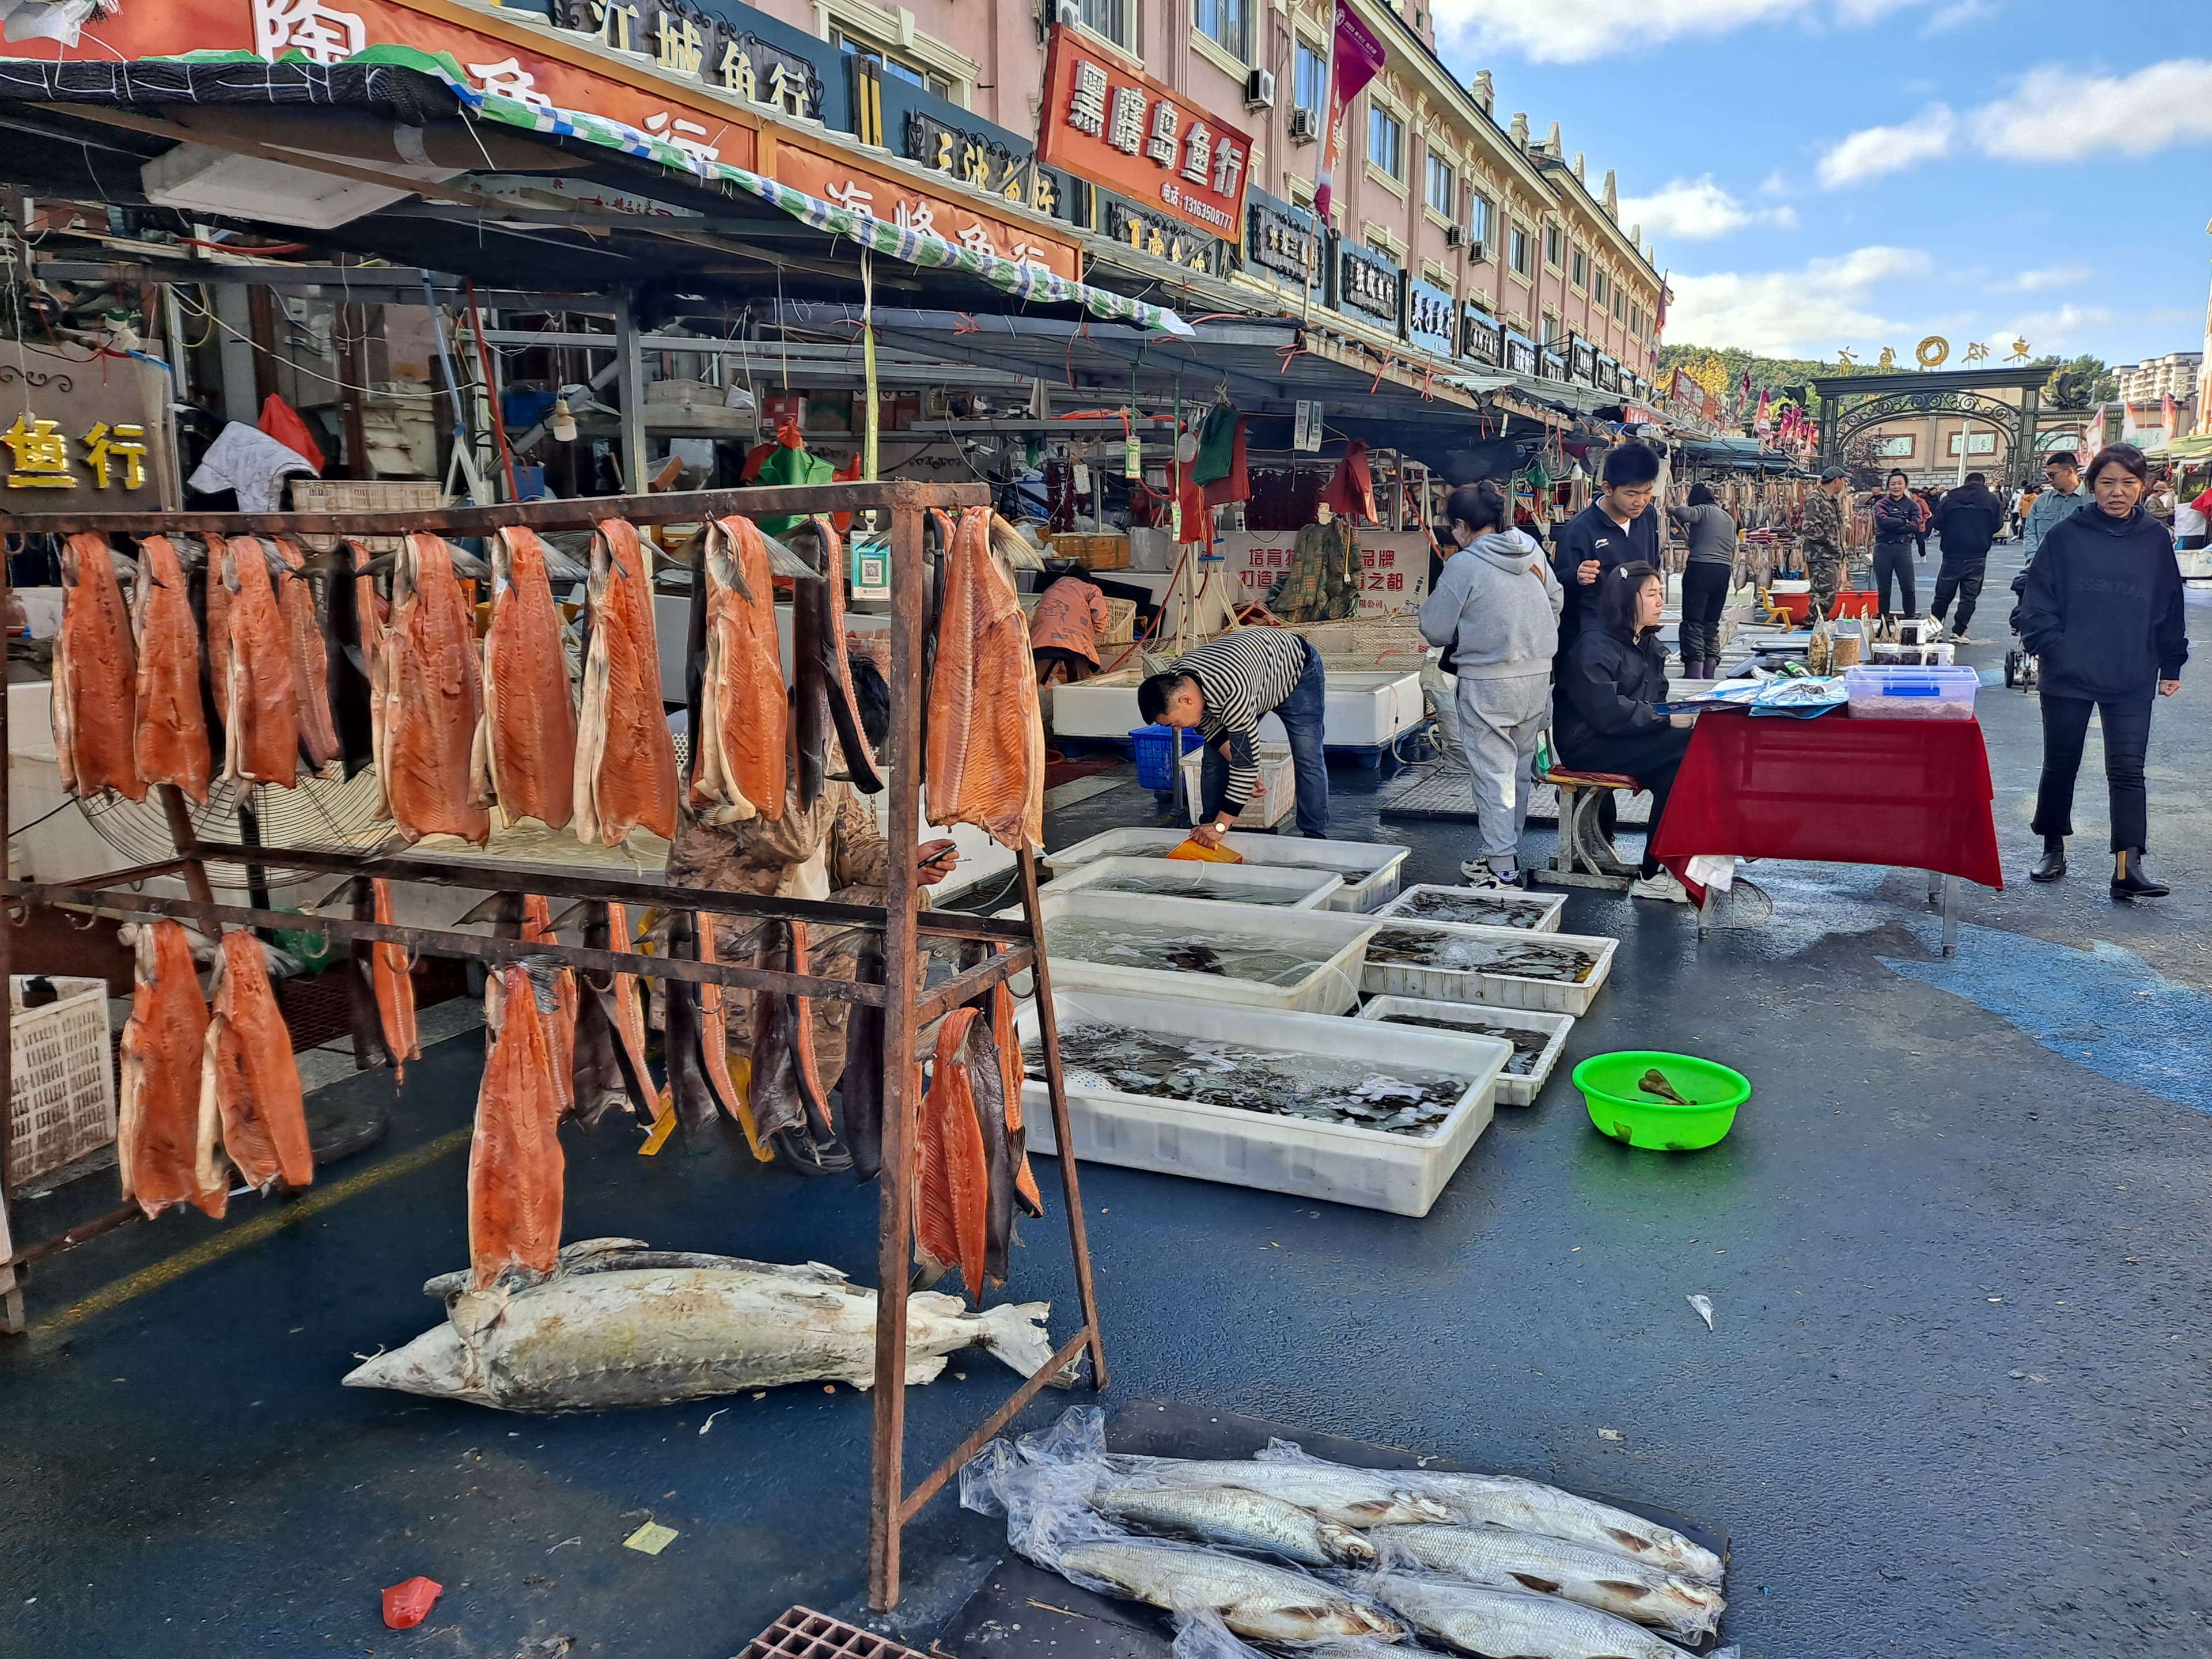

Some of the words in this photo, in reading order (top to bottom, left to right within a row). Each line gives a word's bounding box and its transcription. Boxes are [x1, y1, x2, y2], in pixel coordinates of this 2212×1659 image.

[1069, 60, 1243, 198] 黑瞎岛鱼行
[1240, 570, 1291, 589] 打造
[1359, 572, 1403, 591] 之都
